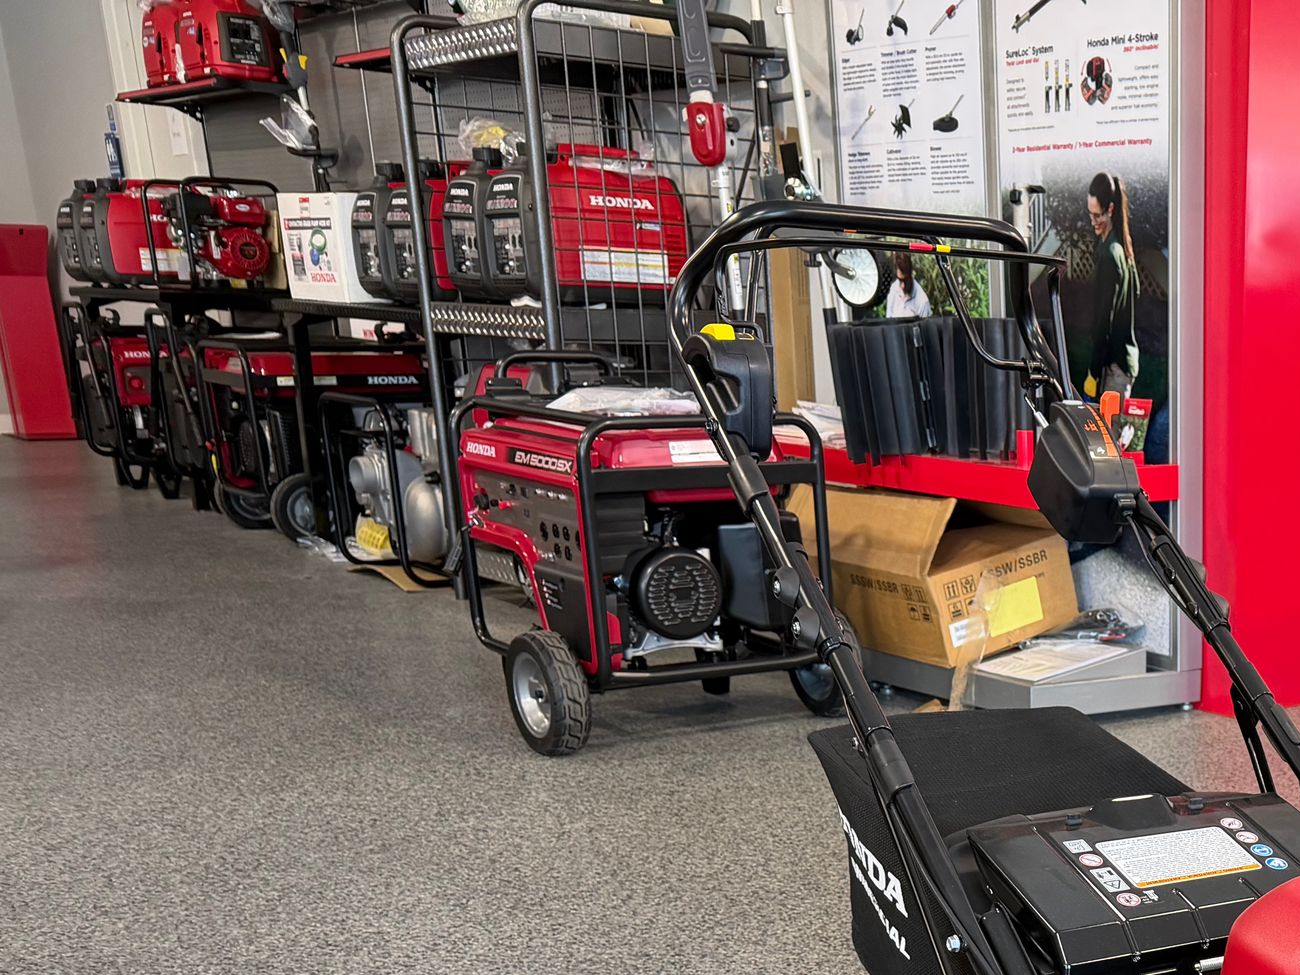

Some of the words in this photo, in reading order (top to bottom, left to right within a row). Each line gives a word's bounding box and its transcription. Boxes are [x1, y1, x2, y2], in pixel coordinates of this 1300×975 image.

[1087, 38, 1109, 48] Honda
[1111, 35, 1126, 46] Mini
[1128, 32, 1158, 44] 4-Stroke
[1032, 45, 1054, 56] System
[589, 194, 655, 210] HONDA
[310, 272, 336, 283] HONDA
[124, 350, 168, 358] HONA
[367, 376, 419, 385] HONDA
[466, 442, 496, 458] HONDA
[514, 451, 572, 473] EM5000SX
[980, 550, 1048, 578] SSW/SSBR
